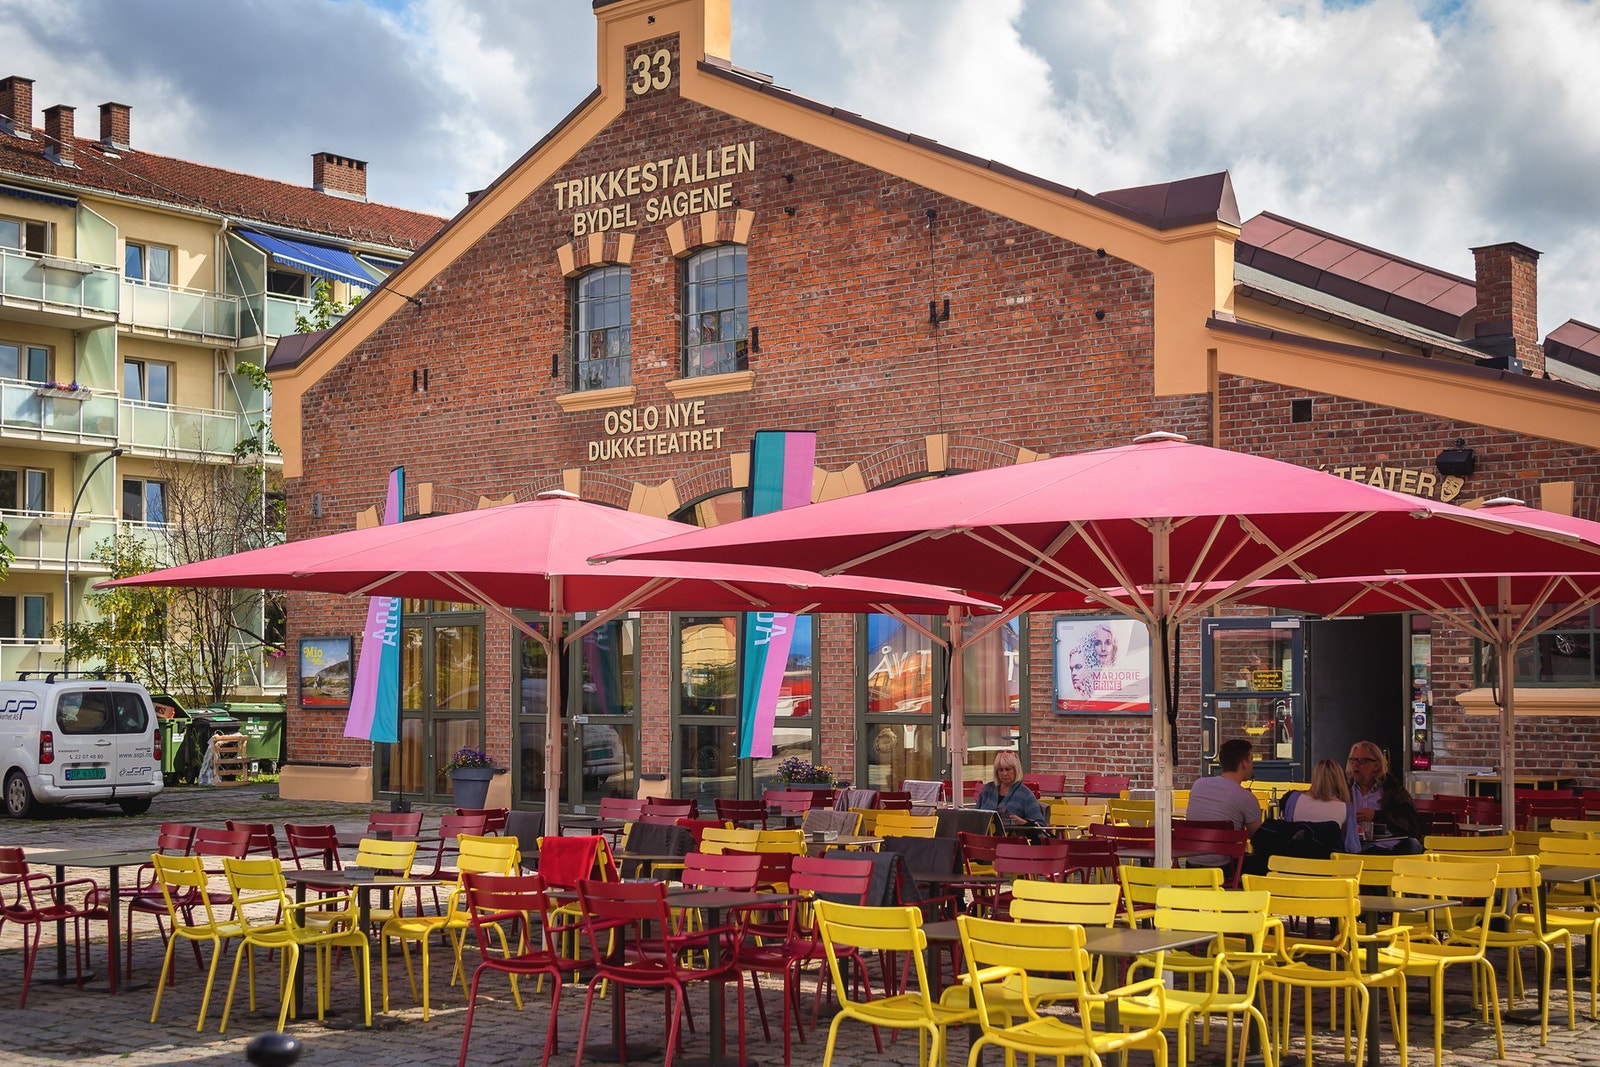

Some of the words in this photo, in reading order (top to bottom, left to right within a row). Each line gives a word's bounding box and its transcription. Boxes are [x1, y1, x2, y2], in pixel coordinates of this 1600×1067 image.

[632, 49, 672, 95] 33
[554, 141, 755, 211] TRIKKESTALLEN
[573, 203, 638, 237] BYDEL
[645, 182, 733, 223] SAGENE
[604, 406, 659, 436] OSLO
[665, 400, 706, 429] NYE
[588, 427, 725, 462] DUKKETEATRET
[1092, 671, 1140, 681] MARJORIE
[1094, 680, 1121, 690] PRIME
